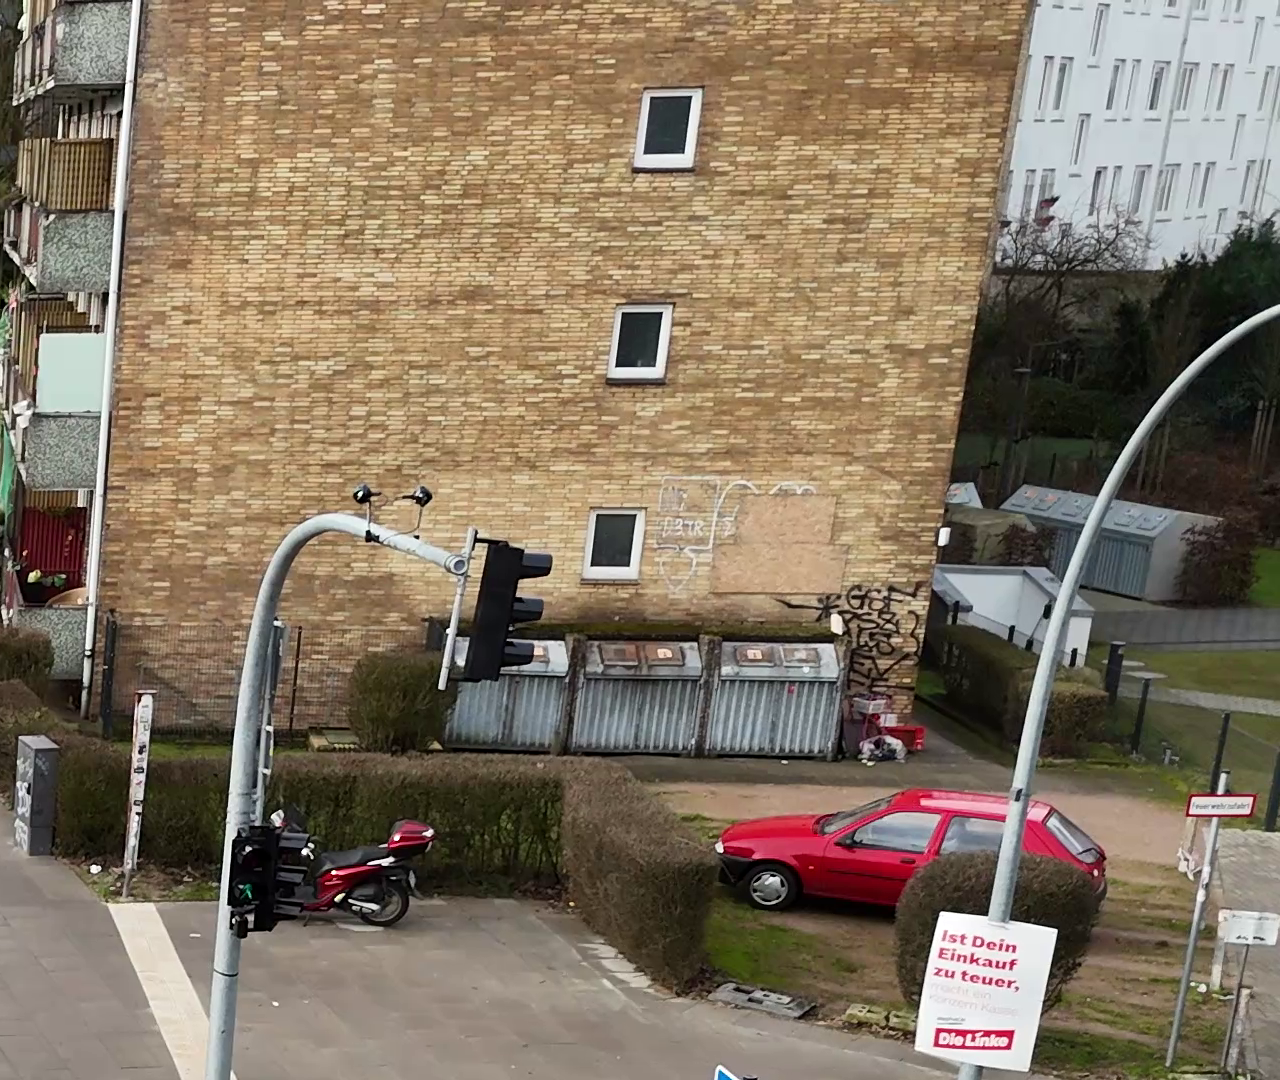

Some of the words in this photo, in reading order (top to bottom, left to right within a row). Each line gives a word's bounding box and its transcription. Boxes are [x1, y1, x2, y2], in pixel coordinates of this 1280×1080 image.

[941, 930, 968, 945] Ist
[971, 935, 1018, 954] Dein
[937, 947, 1019, 971] Einkauf
[931, 982, 970, 995] macht
[973, 991, 992, 1000] ein
[933, 966, 956, 980] zu
[960, 970, 1021, 993] teuer,
[930, 994, 978, 1011] Konzern
[981, 1002, 1019, 1016] Kasse
[938, 1032, 964, 1047] Die
[964, 1032, 1010, 1047] Linke
